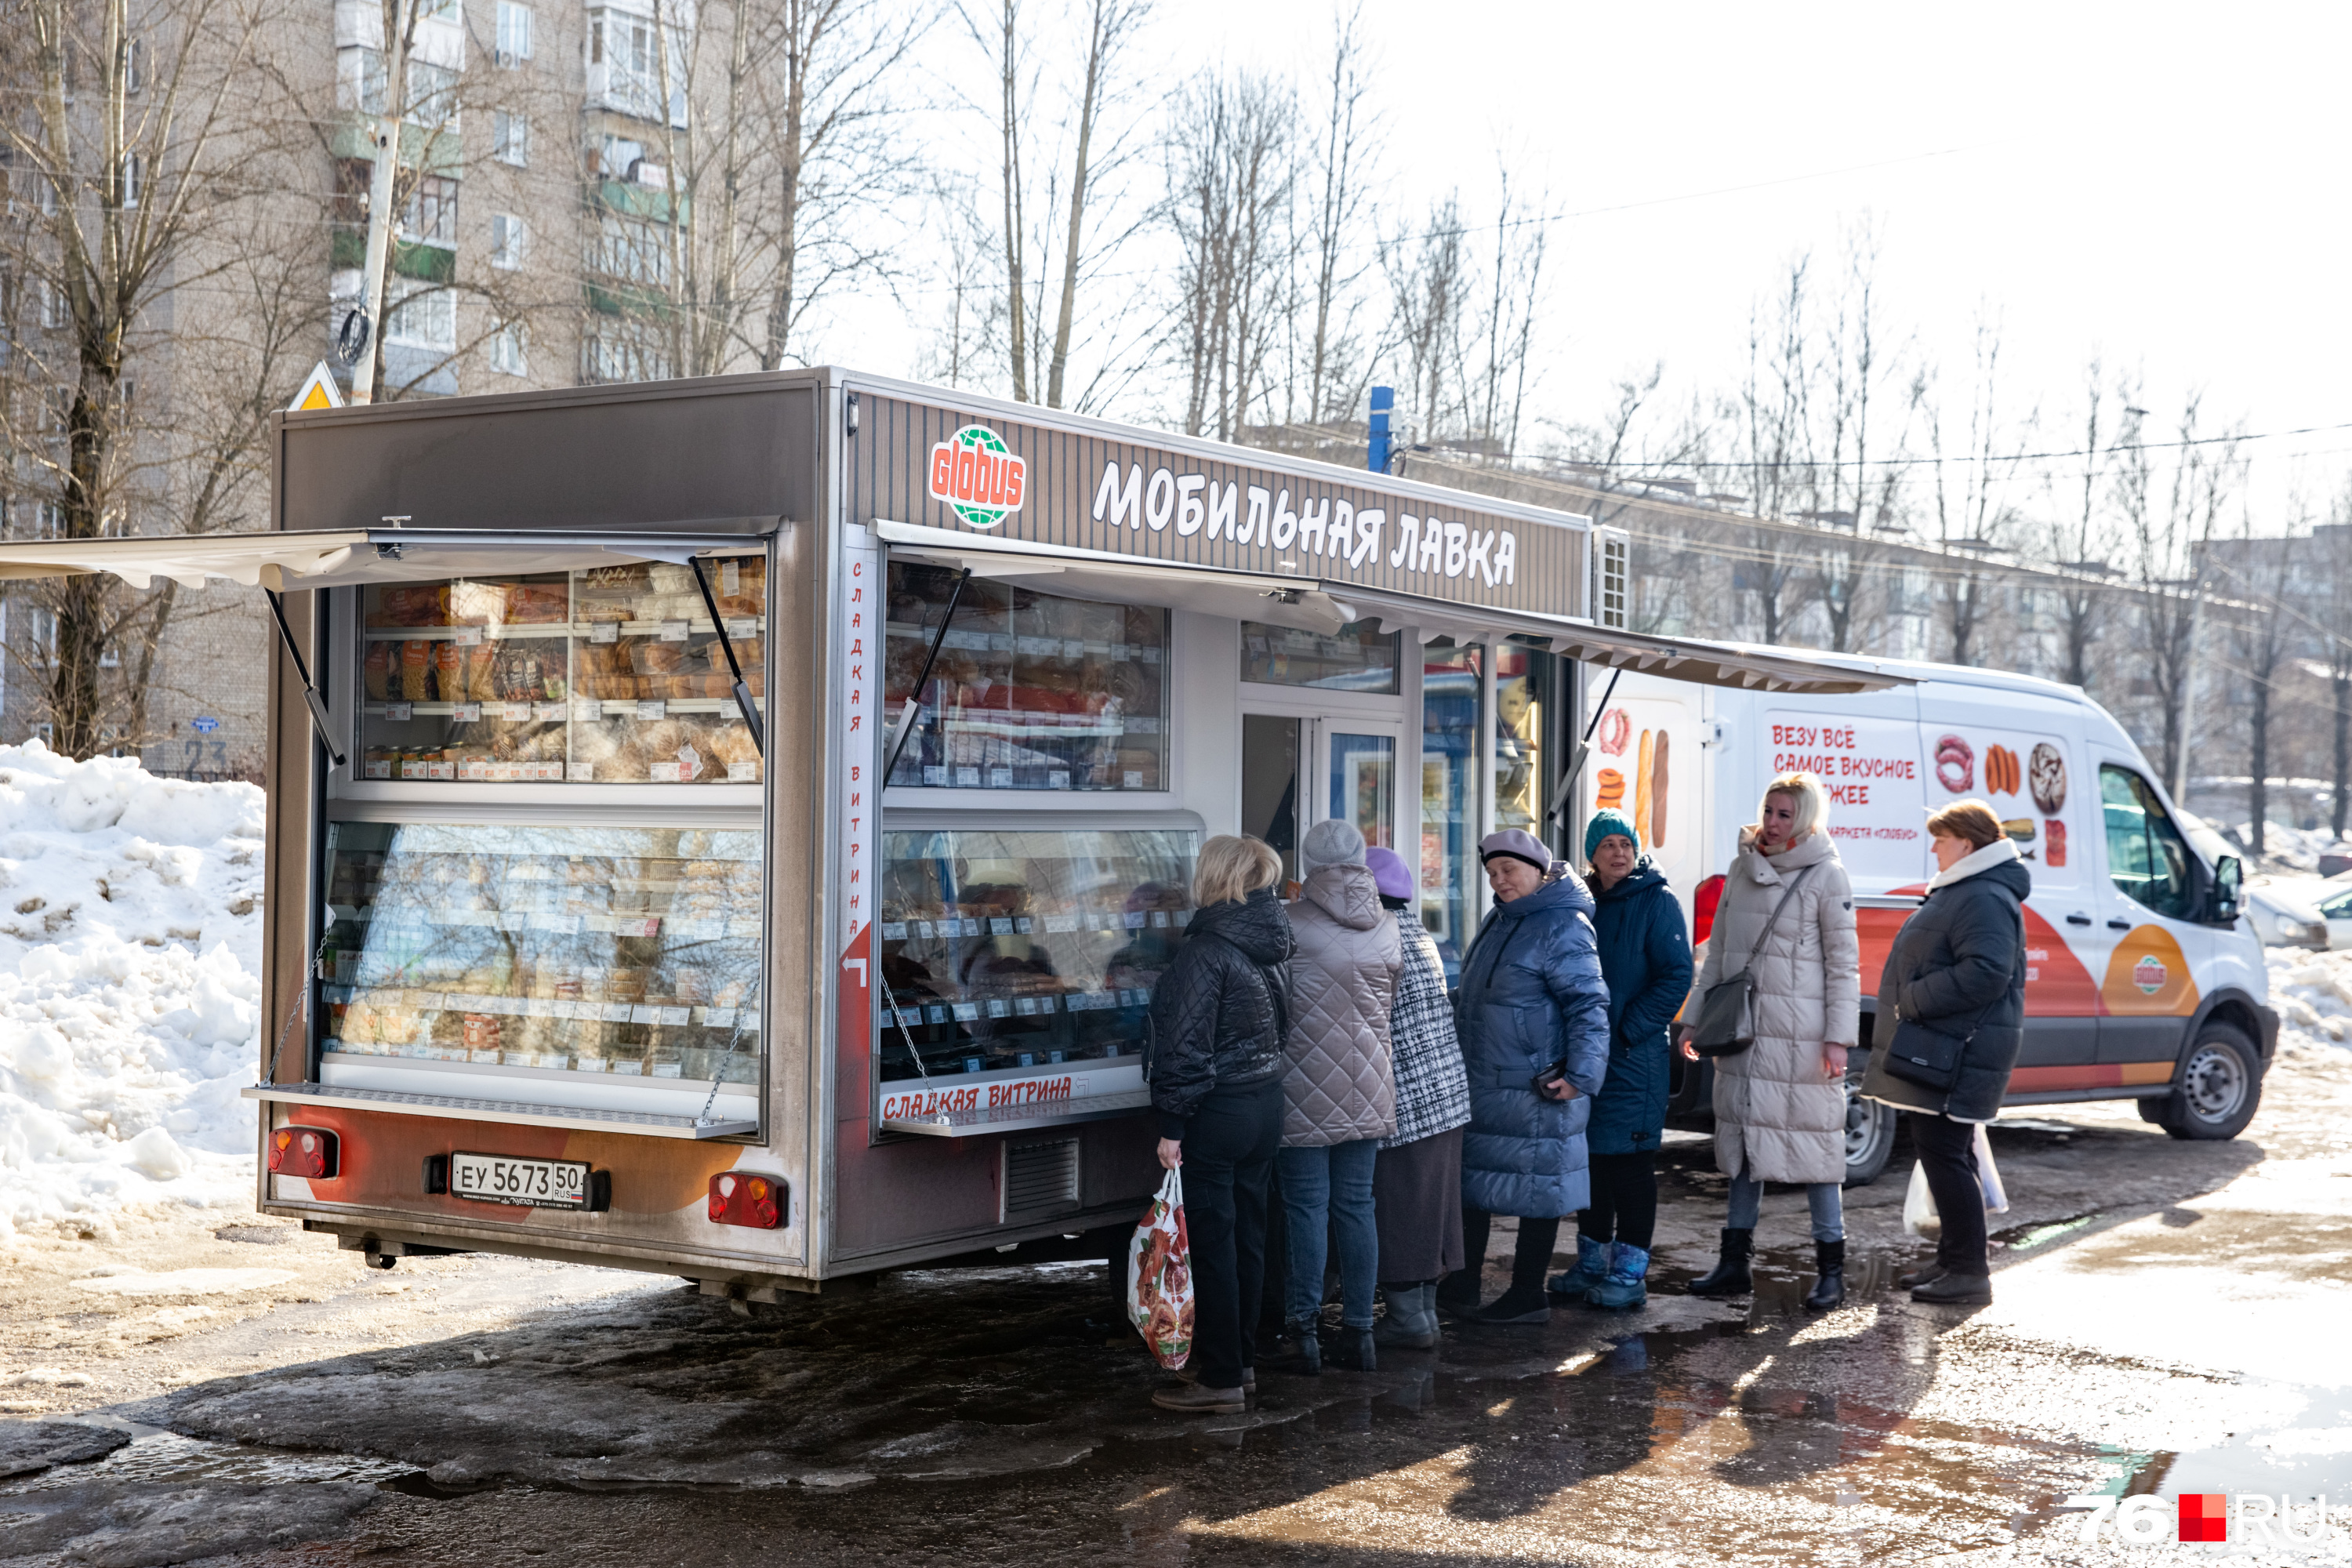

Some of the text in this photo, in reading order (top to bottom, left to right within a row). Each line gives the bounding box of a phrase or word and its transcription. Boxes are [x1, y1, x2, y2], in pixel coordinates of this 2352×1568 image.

[932, 440, 1023, 506] Globus
[1092, 459, 1515, 589] МОБИЛЬНАЯ ЛАВКА
[849, 562, 862, 935] СЛАДКАЯ ВИТРИНА
[1772, 724, 1856, 750] ВЕЗУ ВСЁ
[1774, 753, 1915, 779] САМОЕ ВКУСНОЕ
[884, 1076, 1072, 1120] СЛАДКАЯ ВИТРИНА
[462, 1162, 578, 1195] ЕУ 5673 50
[554, 1189, 571, 1199] RUS
